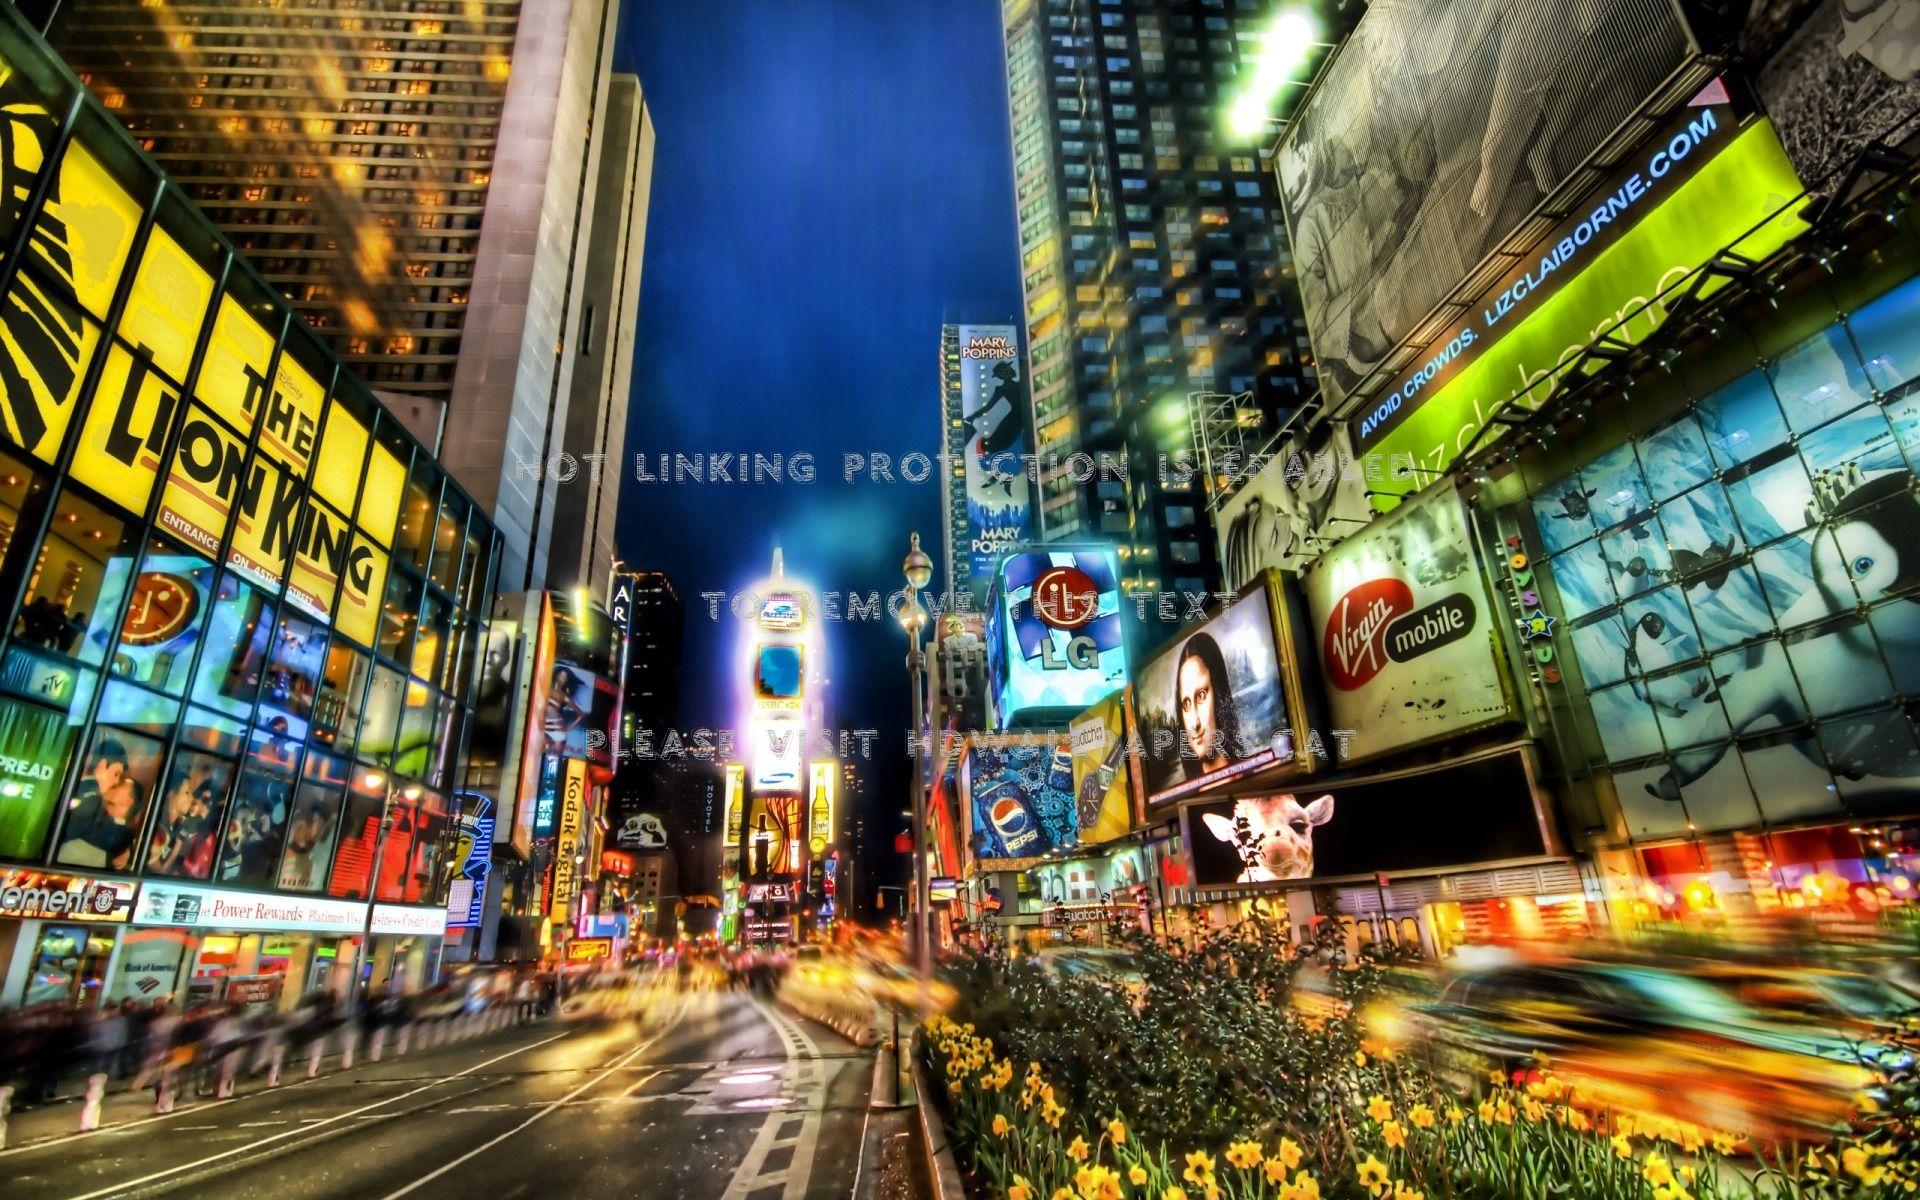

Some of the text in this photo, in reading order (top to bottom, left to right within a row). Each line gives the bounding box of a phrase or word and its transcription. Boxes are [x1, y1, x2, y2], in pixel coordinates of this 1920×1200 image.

[1361, 108, 1717, 439] AVOID CROWDS. LIZCLAIBORNE.COM
[962, 345, 1017, 359] POPPINS
[970, 336, 1008, 348] MARY
[242, 362, 314, 460] THE
[104, 341, 374, 595] LION KING
[163, 511, 314, 605] ENTRANCE ON 45TH STREET
[980, 527, 1020, 541] MARY
[1041, 636, 1099, 670] LG
[1333, 597, 1464, 677] Virgin mobile
[563, 775, 581, 834] Kodak
[705, 785, 714, 833] NOVOTEL
[1005, 828, 1038, 853] PEPSI
[213, 899, 253, 919] Power
[256, 902, 303, 922] Rewards
[370, 911, 401, 927] usiness
